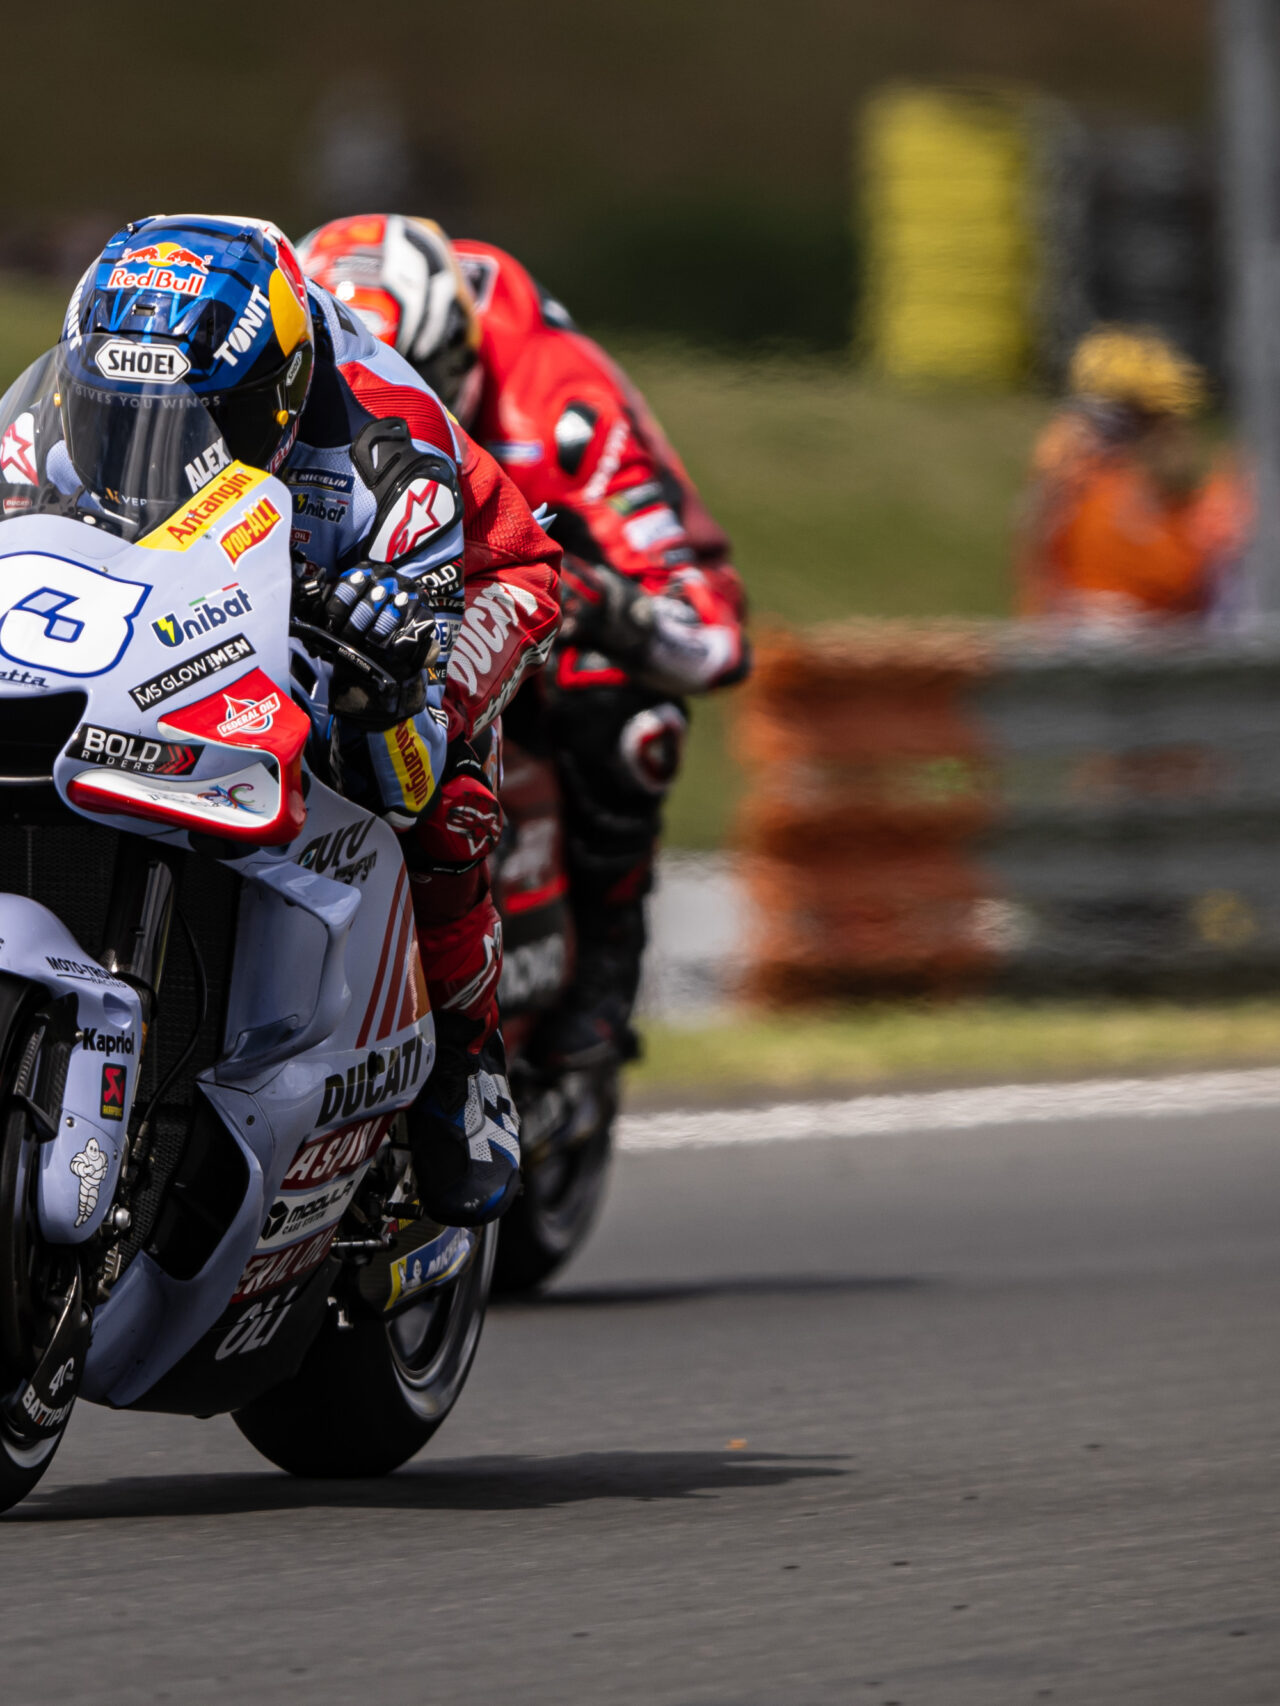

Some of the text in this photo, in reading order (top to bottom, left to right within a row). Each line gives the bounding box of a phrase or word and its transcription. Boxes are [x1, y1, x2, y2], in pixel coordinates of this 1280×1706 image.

[107, 267, 207, 297] Red Bull
[213, 284, 271, 368] TONIT
[107, 348, 176, 376] SHOEI
[74, 384, 222, 410] GIVES YOU WINGS
[183, 436, 232, 494] ALEX
[300, 473, 349, 488] MICHELIN
[167, 472, 253, 545] Antangin
[292, 493, 347, 524] Unibat
[222, 497, 281, 559] YOU-ALL
[152, 588, 254, 648] Unibat
[132, 638, 251, 706] MS GLOW MEN
[221, 699, 277, 733] FEDERAL OIL
[80, 749, 156, 773] RIDERS
[83, 727, 162, 763] BOLD
[83, 1027, 135, 1057] Kapriol
[315, 1032, 424, 1129] DUCATI
[235, 1245, 304, 1295] ERAL
